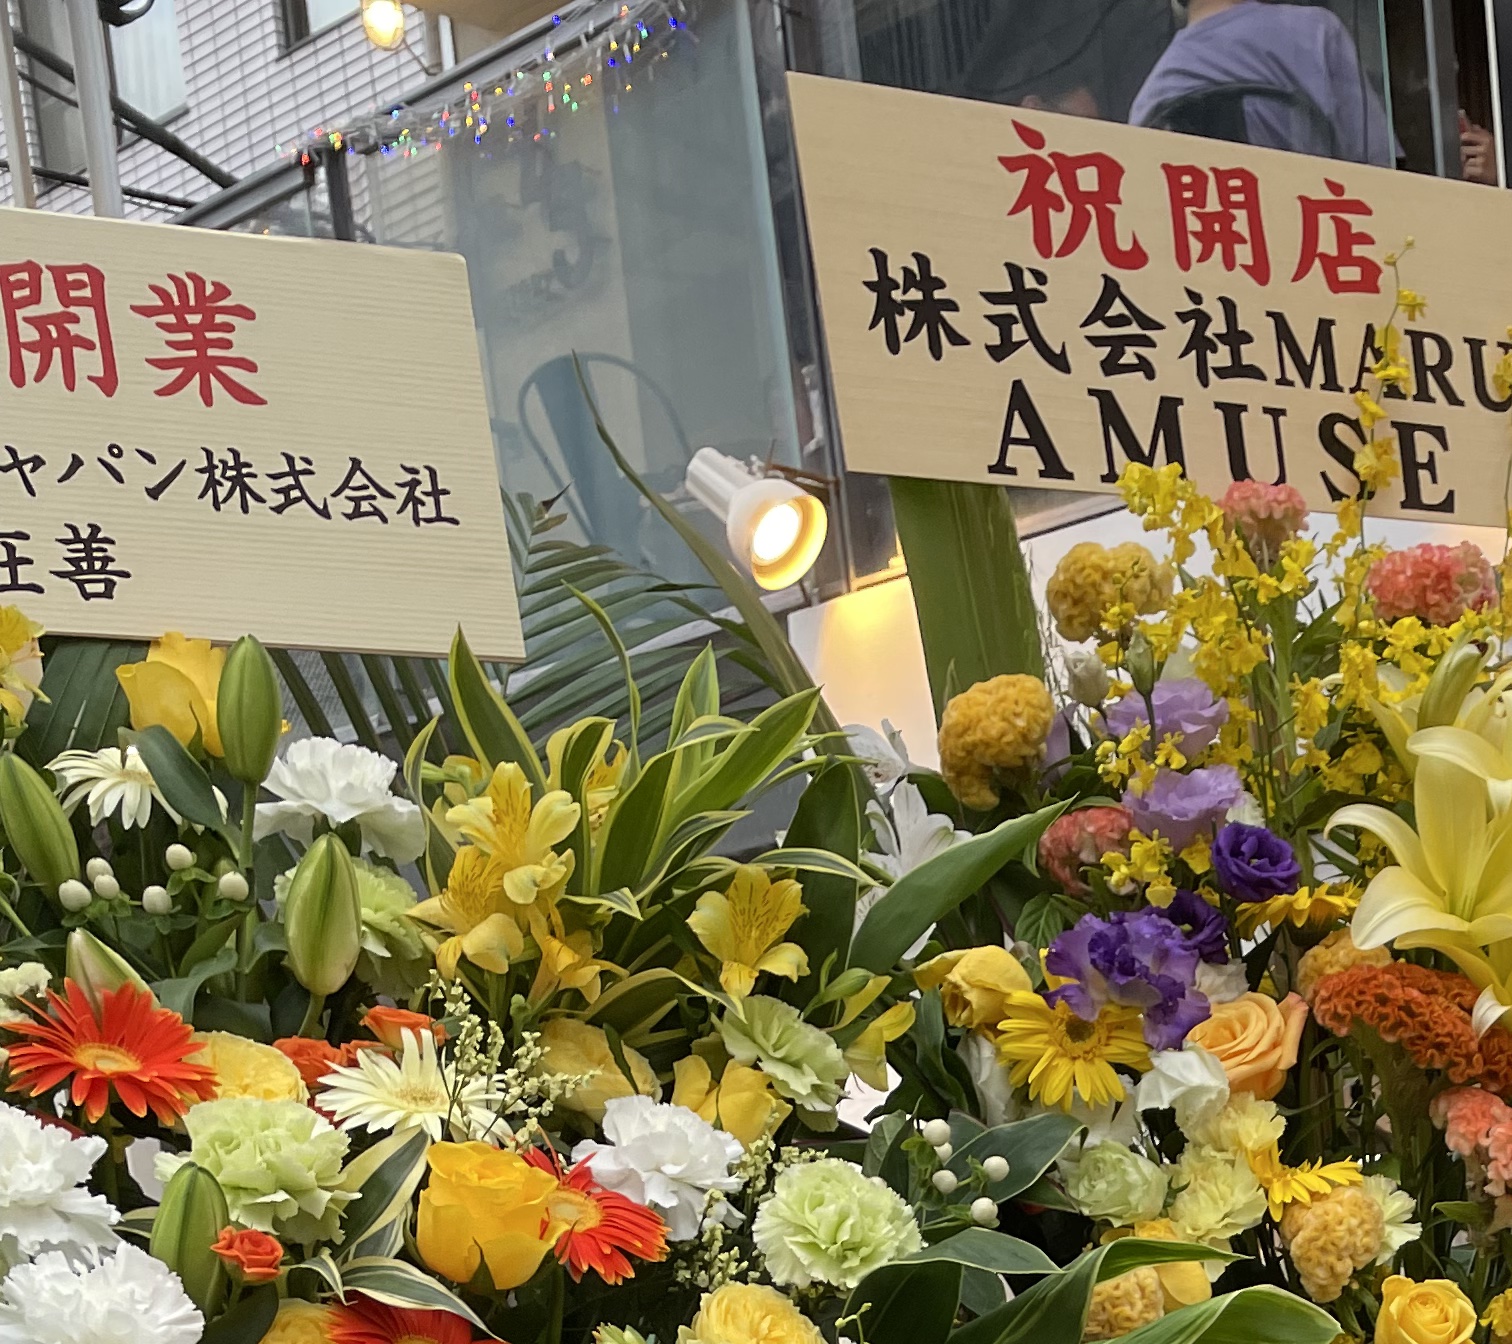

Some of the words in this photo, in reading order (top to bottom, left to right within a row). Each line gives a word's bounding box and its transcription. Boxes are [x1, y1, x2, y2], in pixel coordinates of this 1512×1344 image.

[997, 119, 1384, 295] 祝開店
[0, 260, 268, 408] 開業
[987, 378, 1456, 514] AMUSE
